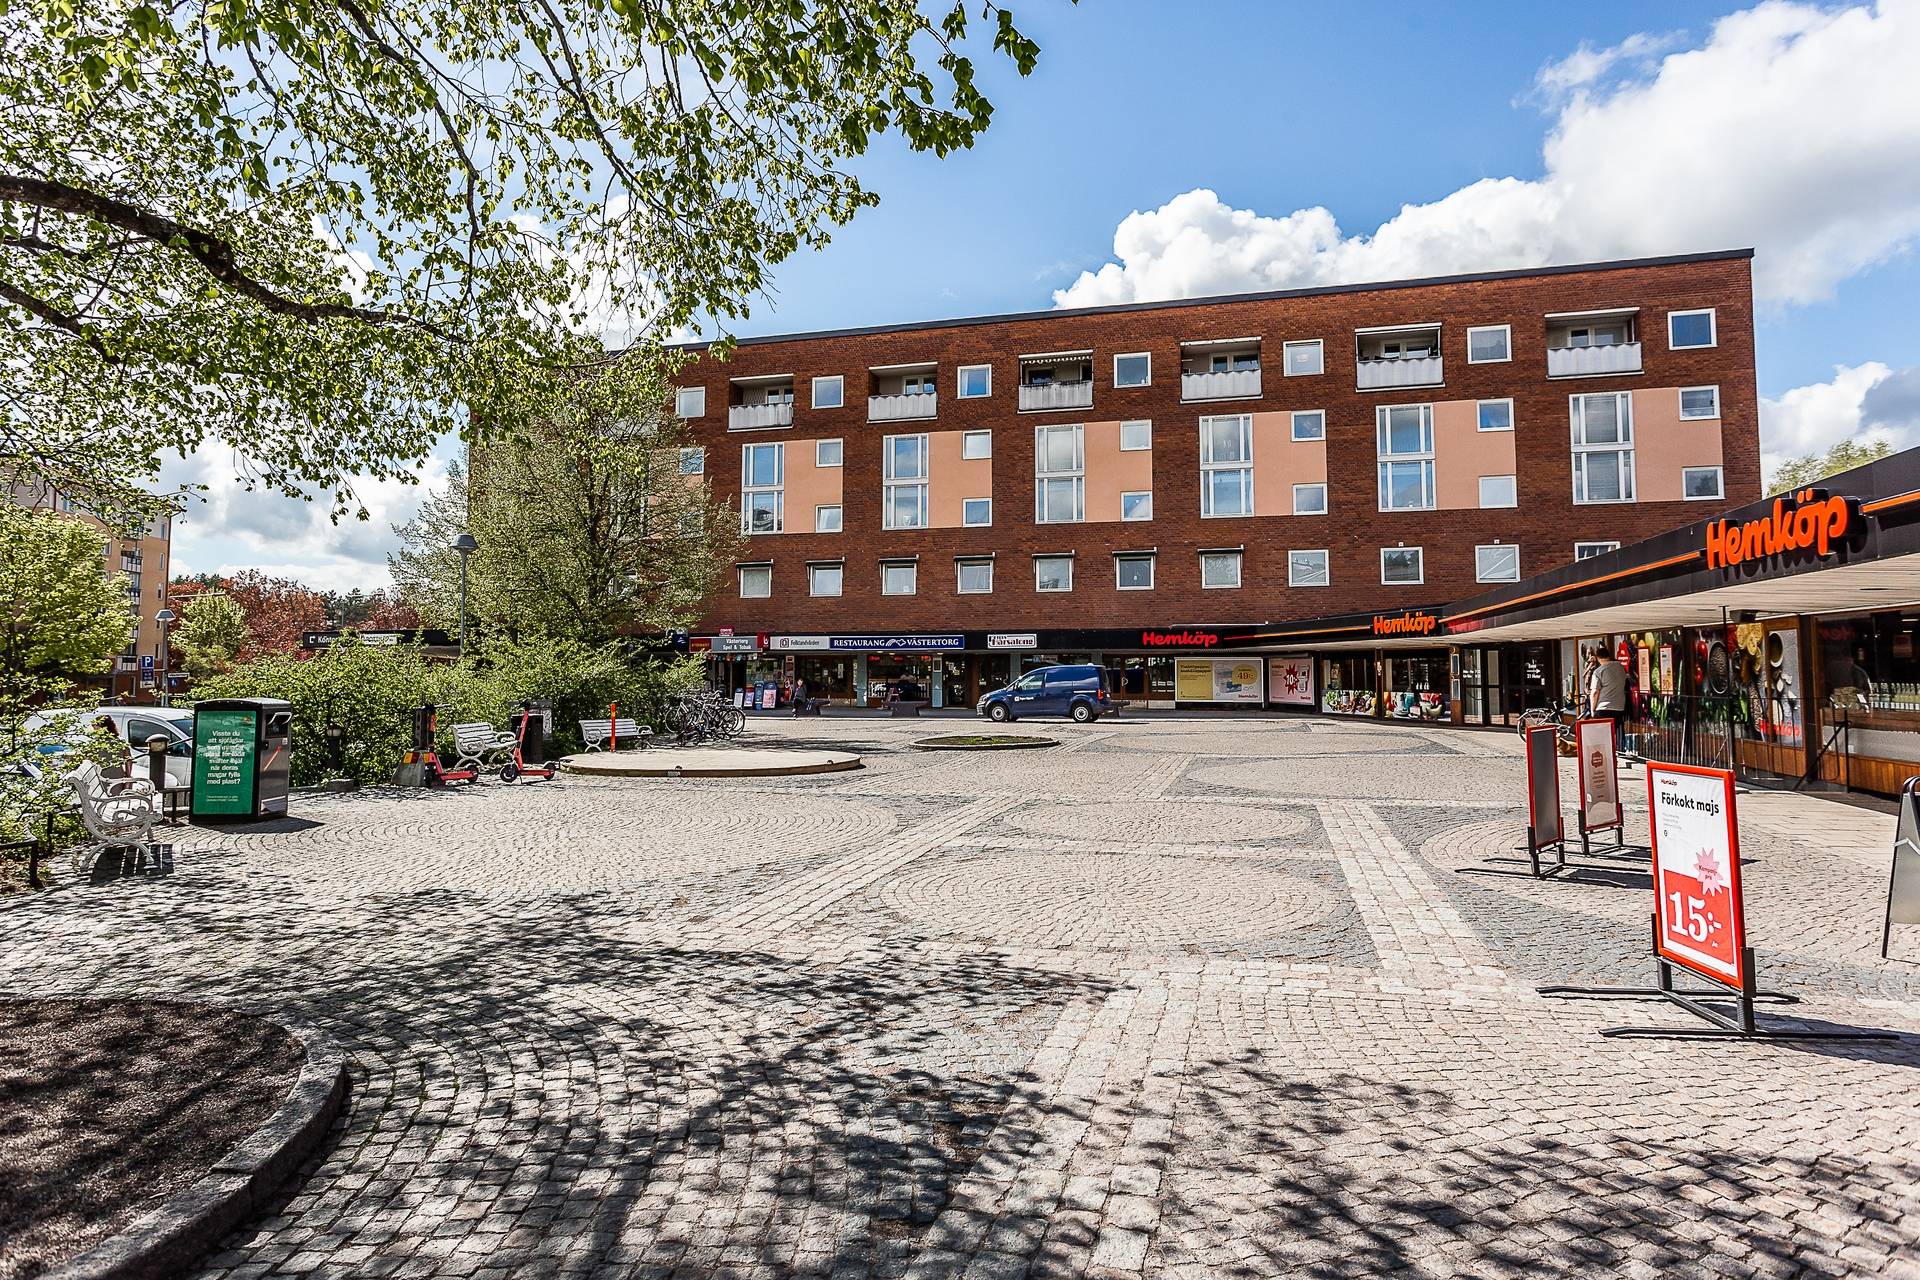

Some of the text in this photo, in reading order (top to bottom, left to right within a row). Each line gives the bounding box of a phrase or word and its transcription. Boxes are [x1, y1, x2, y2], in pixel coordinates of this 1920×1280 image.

[1706, 488, 1849, 570] Hemköp
[1373, 611, 1436, 635] Hemköp
[833, 637, 959, 647] RESTAURANG VÄSTERTORG
[1142, 631, 1218, 648] Hemköp
[145, 656, 152, 667] P
[221, 778, 241, 786] plast?
[228, 771, 241, 779] fylls
[1661, 791, 1720, 817] Förkokt majs
[1669, 891, 1722, 943] 15:-
